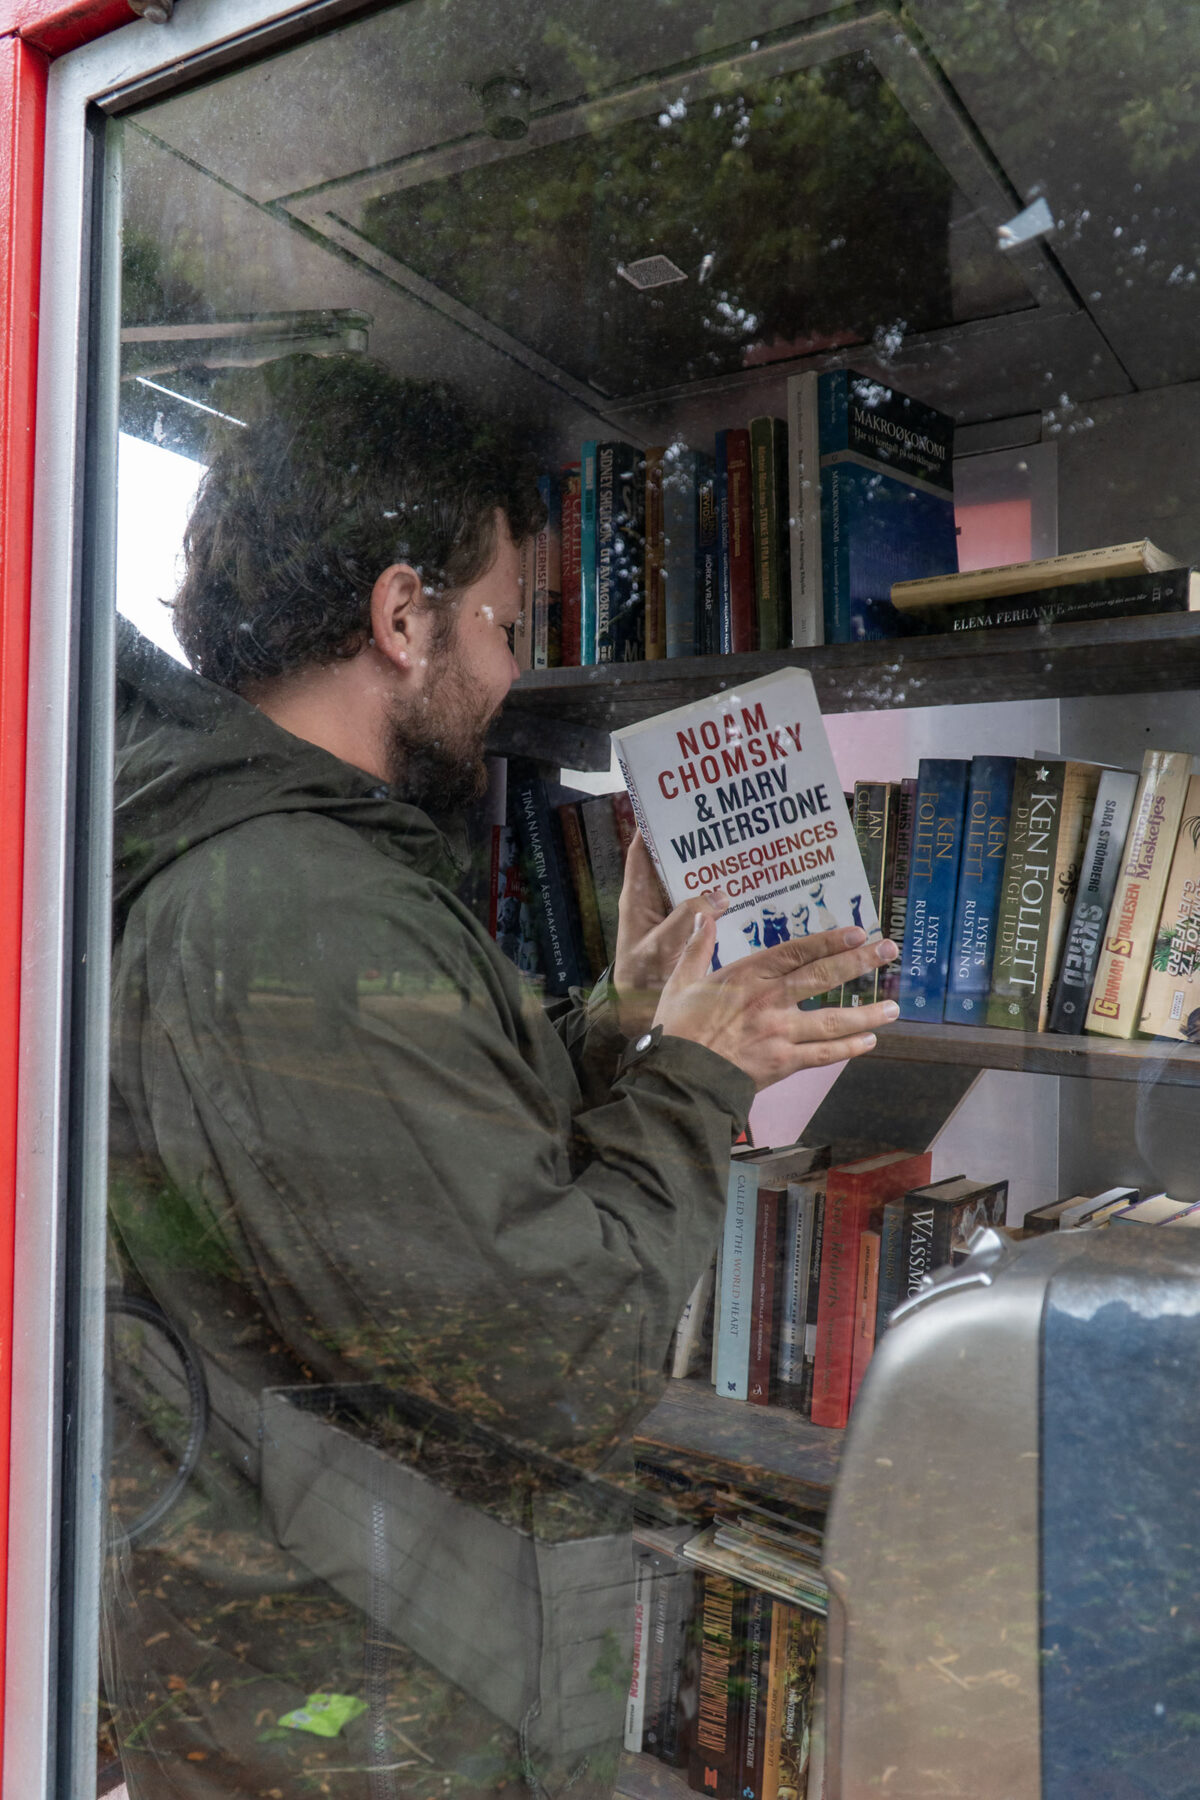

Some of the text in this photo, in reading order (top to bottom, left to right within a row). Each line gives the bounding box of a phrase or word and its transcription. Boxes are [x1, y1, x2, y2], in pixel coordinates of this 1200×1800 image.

[854, 407, 946, 460] MAKROØKONOMI
[600, 449, 613, 488] SIDNEY
[537, 533, 547, 593] GUERNSEY
[563, 500, 571, 577] SAMARTIN
[571, 498, 582, 576] CECILIA
[600, 563, 610, 580] AV
[599, 581, 609, 634] MØRKET
[953, 614, 992, 631] ELENA
[996, 602, 1065, 625] FERRANTE
[676, 702, 769, 759] NOAM
[657, 722, 803, 800] CHOMSKY
[521, 789, 536, 824] TINA
[694, 764, 789, 823] & MARV
[899, 793, 912, 830] HANS
[528, 823, 538, 837] N
[670, 783, 832, 864] WATERSTONE
[867, 810, 883, 839] JAN
[915, 791, 939, 884] FOLLETT
[936, 817, 956, 860] KEN
[964, 790, 991, 884] FOLLETT
[986, 816, 1007, 859] KEN
[1134, 795, 1167, 881] Maskefjes
[529, 837, 547, 879] MARTIN
[684, 820, 839, 890] CONSEQUENCES
[727, 845, 836, 898] CAPITALISM
[755, 885, 789, 904] Discontent
[789, 881, 802, 892] and
[801, 869, 836, 888] Resistance
[999, 807, 1029, 968] DEN EVIGE ILDEN
[1009, 793, 1057, 995] KEN FOLLETT
[1063, 799, 1117, 988] SARA STRÖMBERG SKRED
[910, 899, 927, 977] RUSTNING
[924, 915, 940, 964] LYSETS
[959, 900, 977, 979] RUSTNING
[974, 916, 989, 966] LYSETS
[1091, 883, 1142, 1021] GUNNAR STAALESEN
[1166, 879, 1195, 977] GJENFERD
[831, 1193, 847, 1235] Nora
[729, 1174, 746, 1338] CALLED BY THE WORLD HEART
[827, 1242, 845, 1309] Roberts
